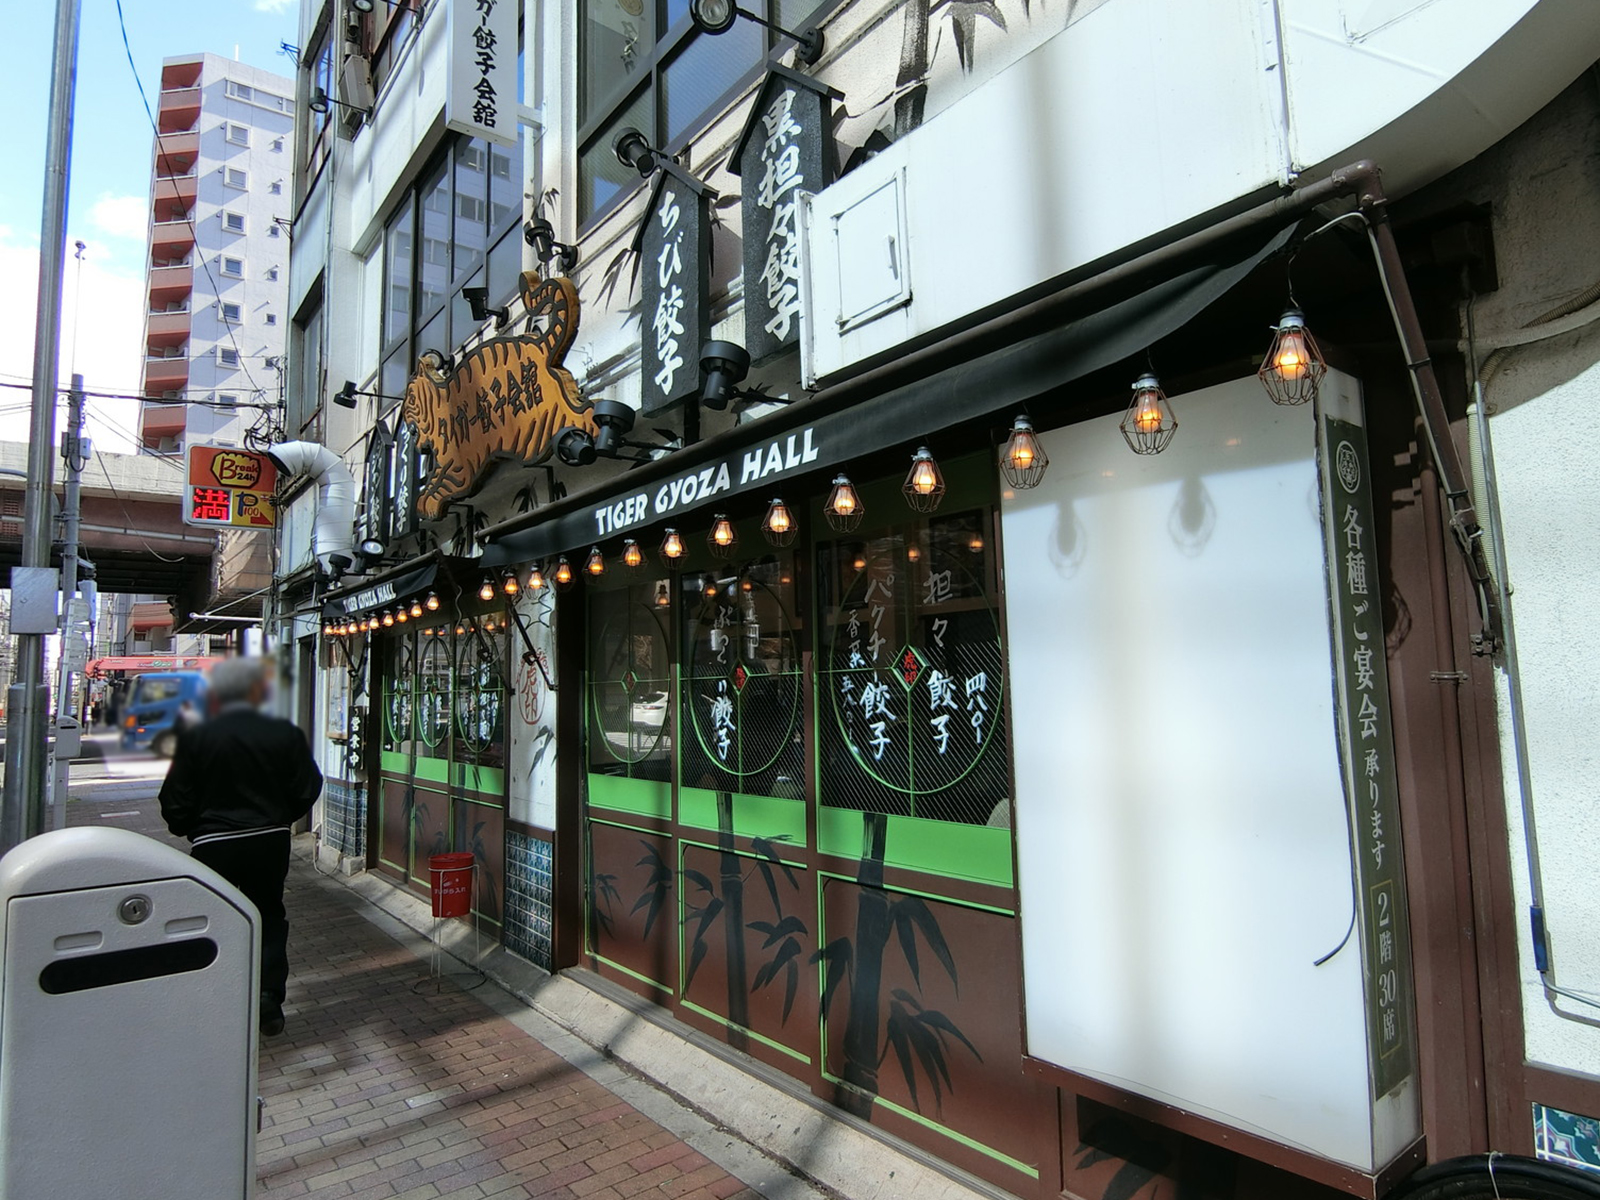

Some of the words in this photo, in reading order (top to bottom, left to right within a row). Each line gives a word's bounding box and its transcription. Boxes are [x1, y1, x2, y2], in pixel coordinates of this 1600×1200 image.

[758, 89, 804, 342] 黒担々餃子
[652, 191, 684, 396] ちび餃子
[219, 455, 259, 480] Break
[236, 472, 256, 481] 24h
[438, 356, 544, 456] タイガー餃子会館
[192, 488, 230, 521] 満
[595, 493, 649, 536] TIGER
[655, 462, 731, 514] GYOZA
[740, 427, 819, 485] HALL
[859, 574, 897, 760] パクチー餃子
[923, 570, 959, 755] 担々餃子
[1343, 504, 1377, 740] 各種ご宴会
[1364, 748, 1386, 871] 承ります
